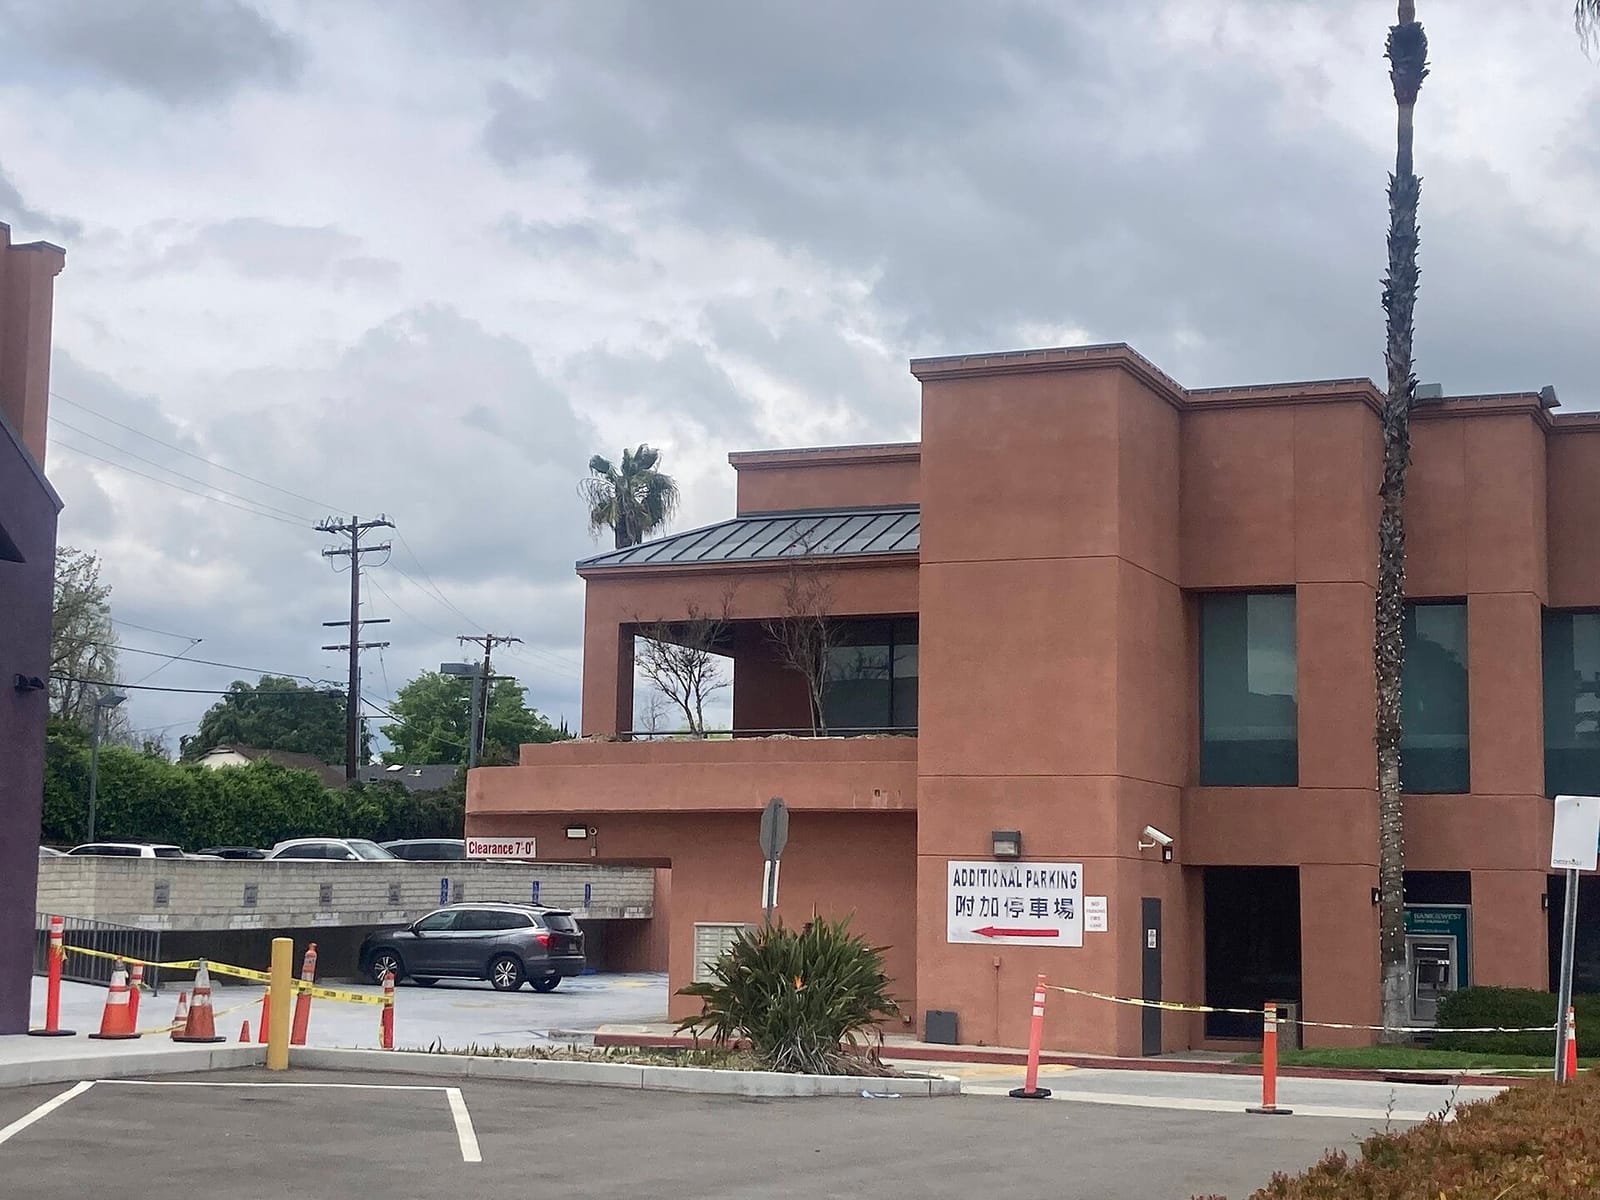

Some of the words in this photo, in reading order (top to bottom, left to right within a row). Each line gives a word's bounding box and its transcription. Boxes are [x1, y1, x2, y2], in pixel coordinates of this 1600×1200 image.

[469, 841, 514, 854] Clearance
[953, 868, 1022, 888] ADDITIONAL
[1026, 870, 1077, 889] PARKING
[955, 895, 1074, 920] 附加停車場
